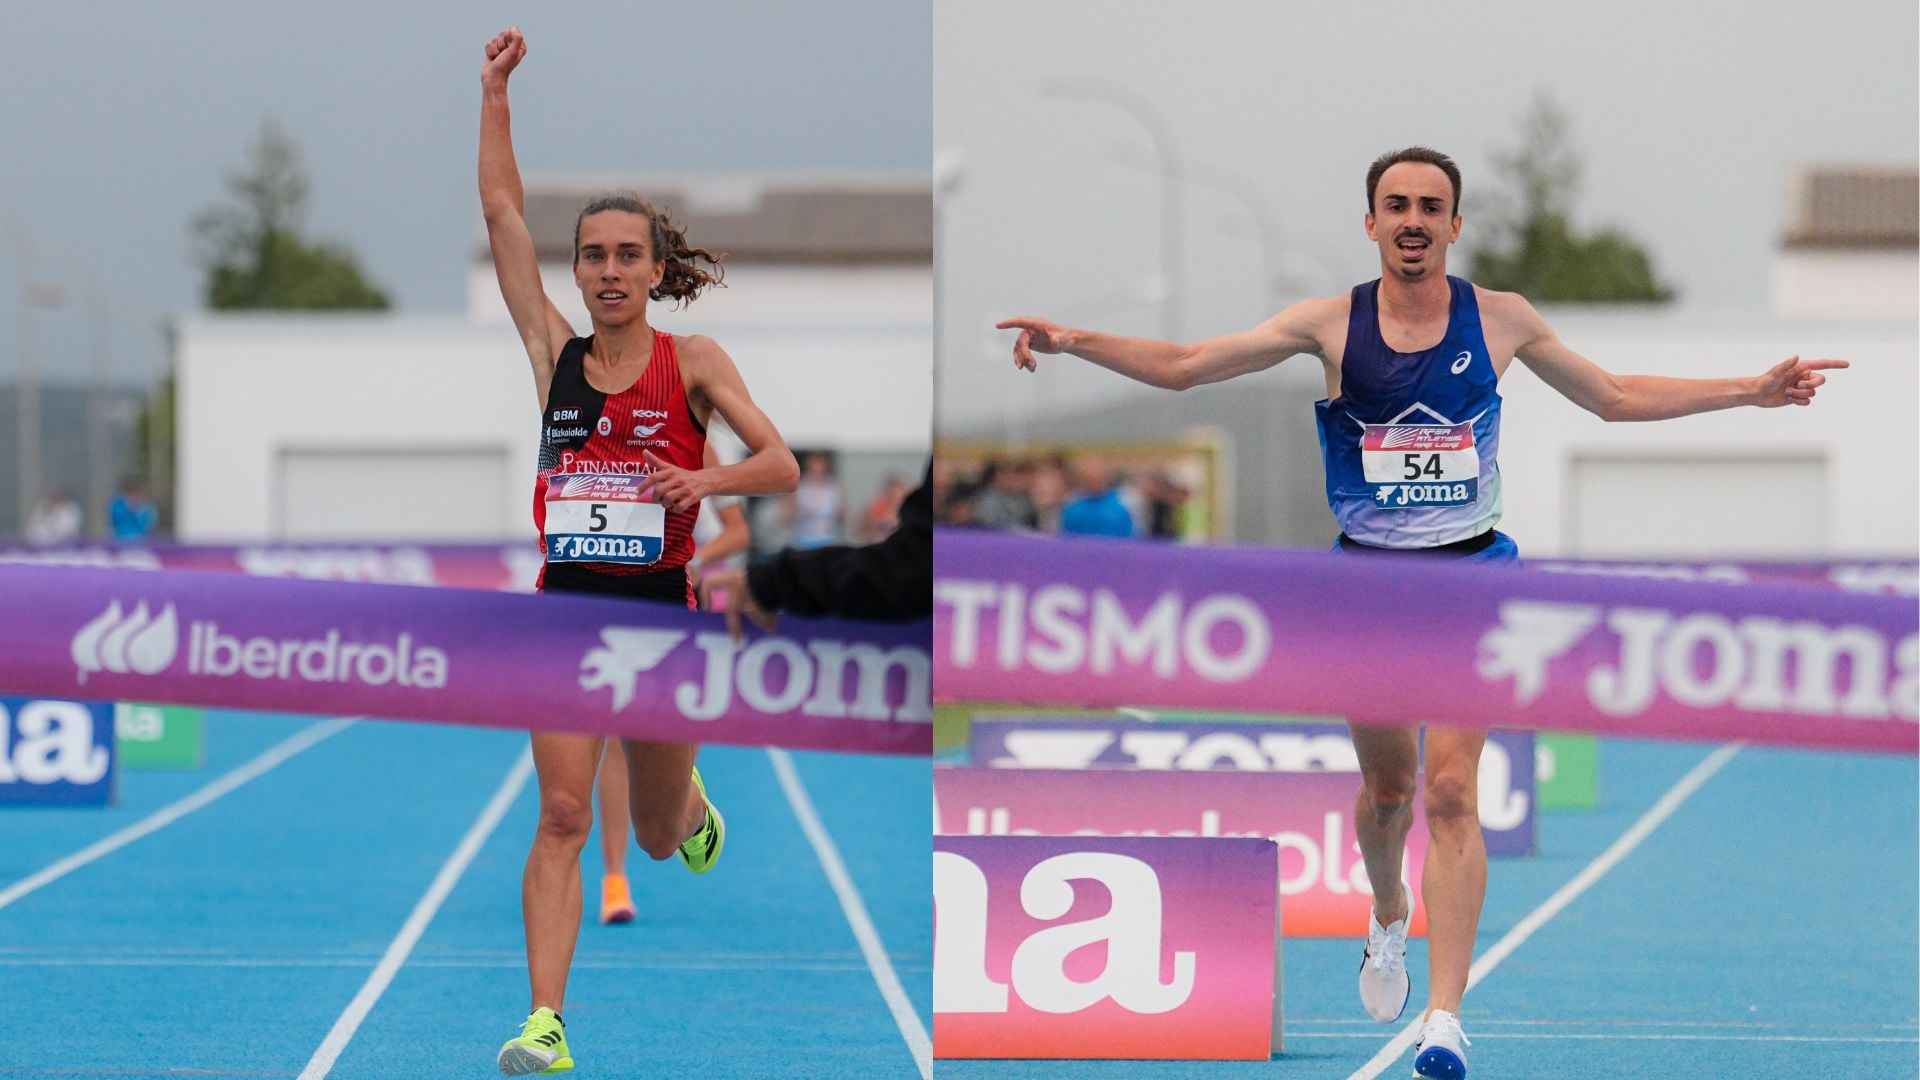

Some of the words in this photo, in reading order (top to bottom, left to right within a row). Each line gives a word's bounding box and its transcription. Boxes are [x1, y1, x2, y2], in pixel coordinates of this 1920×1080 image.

[560, 409, 579, 421] BM
[600, 421, 609, 431] B
[575, 460, 657, 475] FINANCIA
[1404, 453, 1444, 480] 54
[589, 503, 608, 532] 5
[935, 579, 1273, 684] TISMO
[187, 622, 448, 690] Iberdrola
